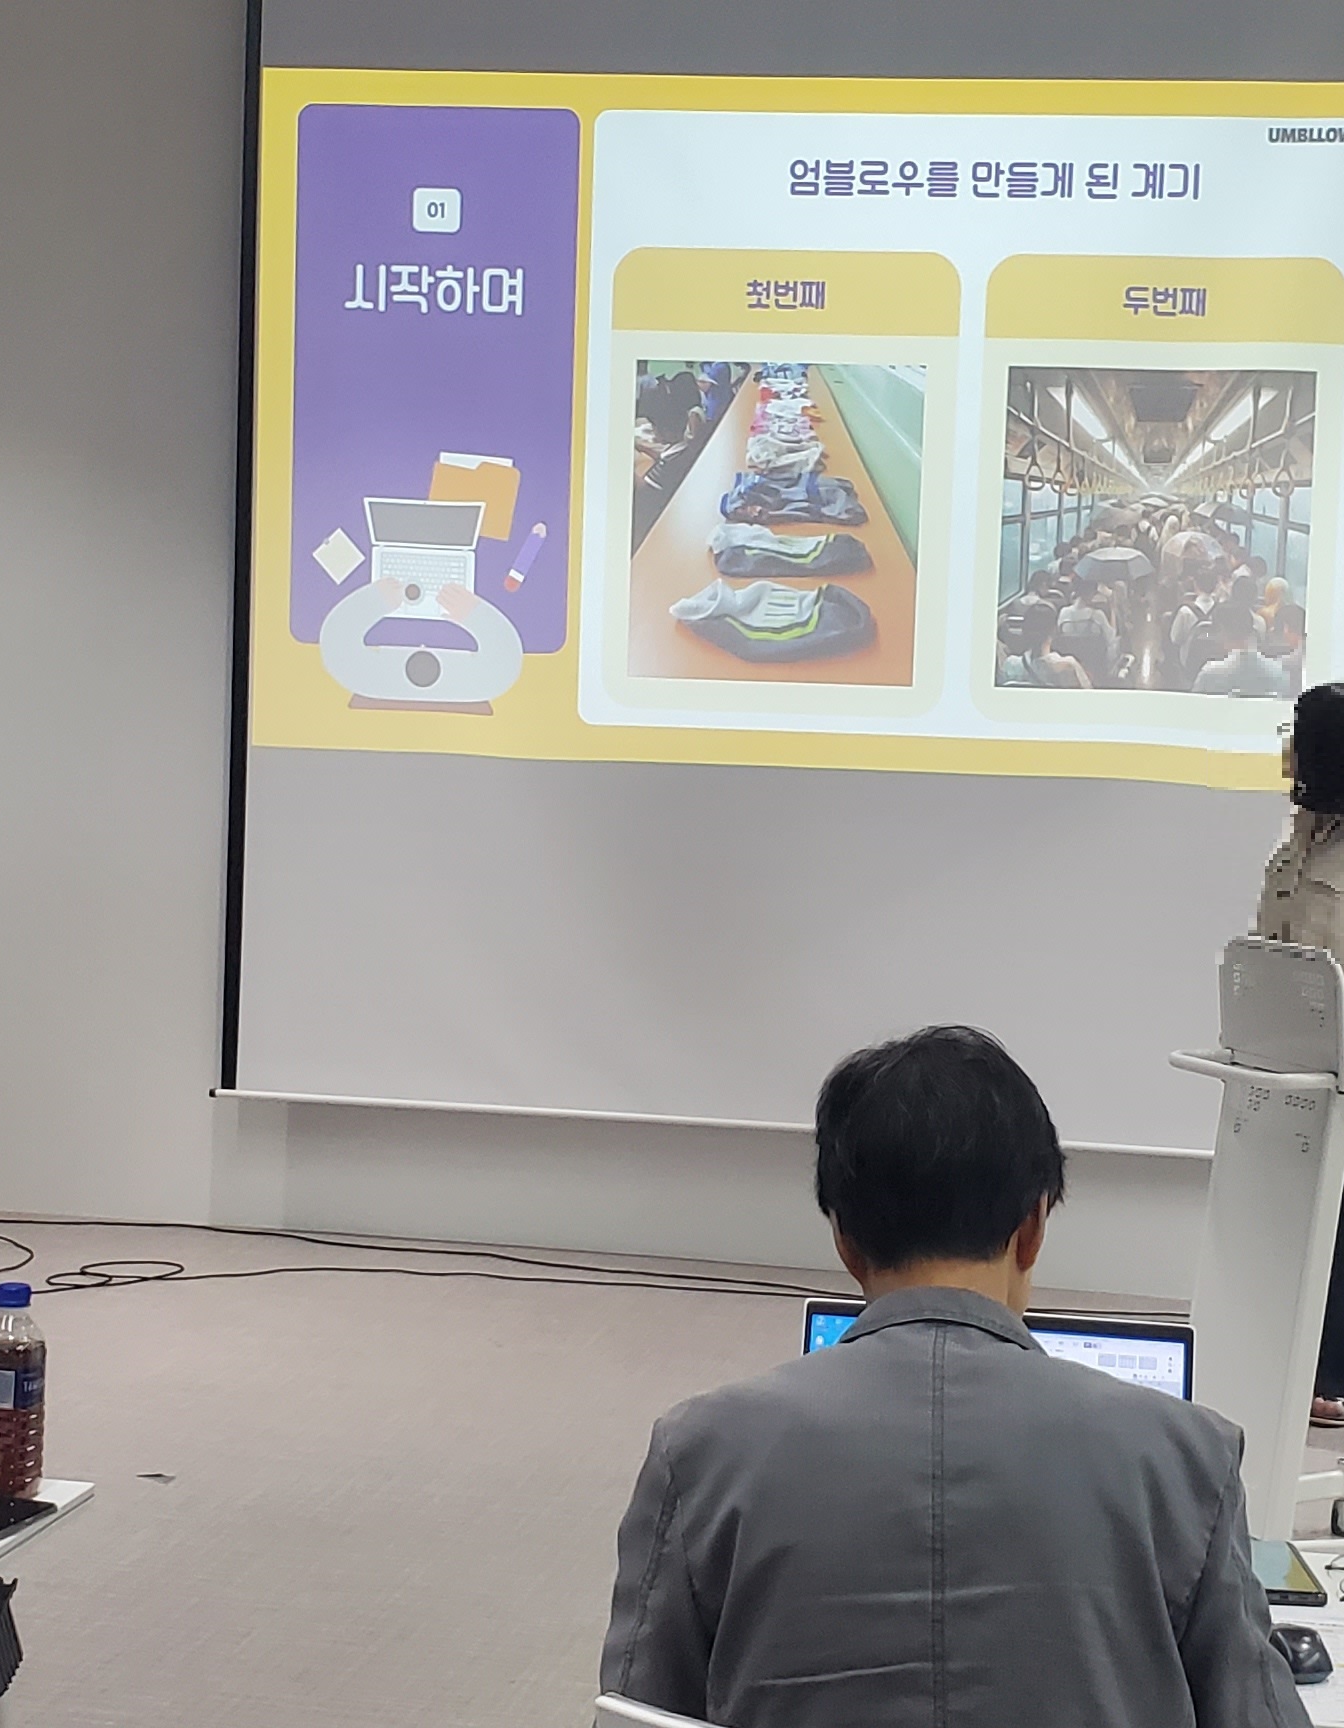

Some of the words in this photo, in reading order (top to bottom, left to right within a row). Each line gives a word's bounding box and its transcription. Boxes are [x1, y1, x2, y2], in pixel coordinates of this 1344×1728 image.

[789, 158, 960, 198] 엄블로우를
[971, 161, 1074, 199] 만들게
[1085, 162, 1119, 200] 된
[1131, 162, 1201, 201] 계기
[426, 201, 447, 219] 01
[344, 264, 524, 316] 시작하며
[745, 279, 826, 310] 첫번째
[1122, 286, 1207, 317] 두번째
